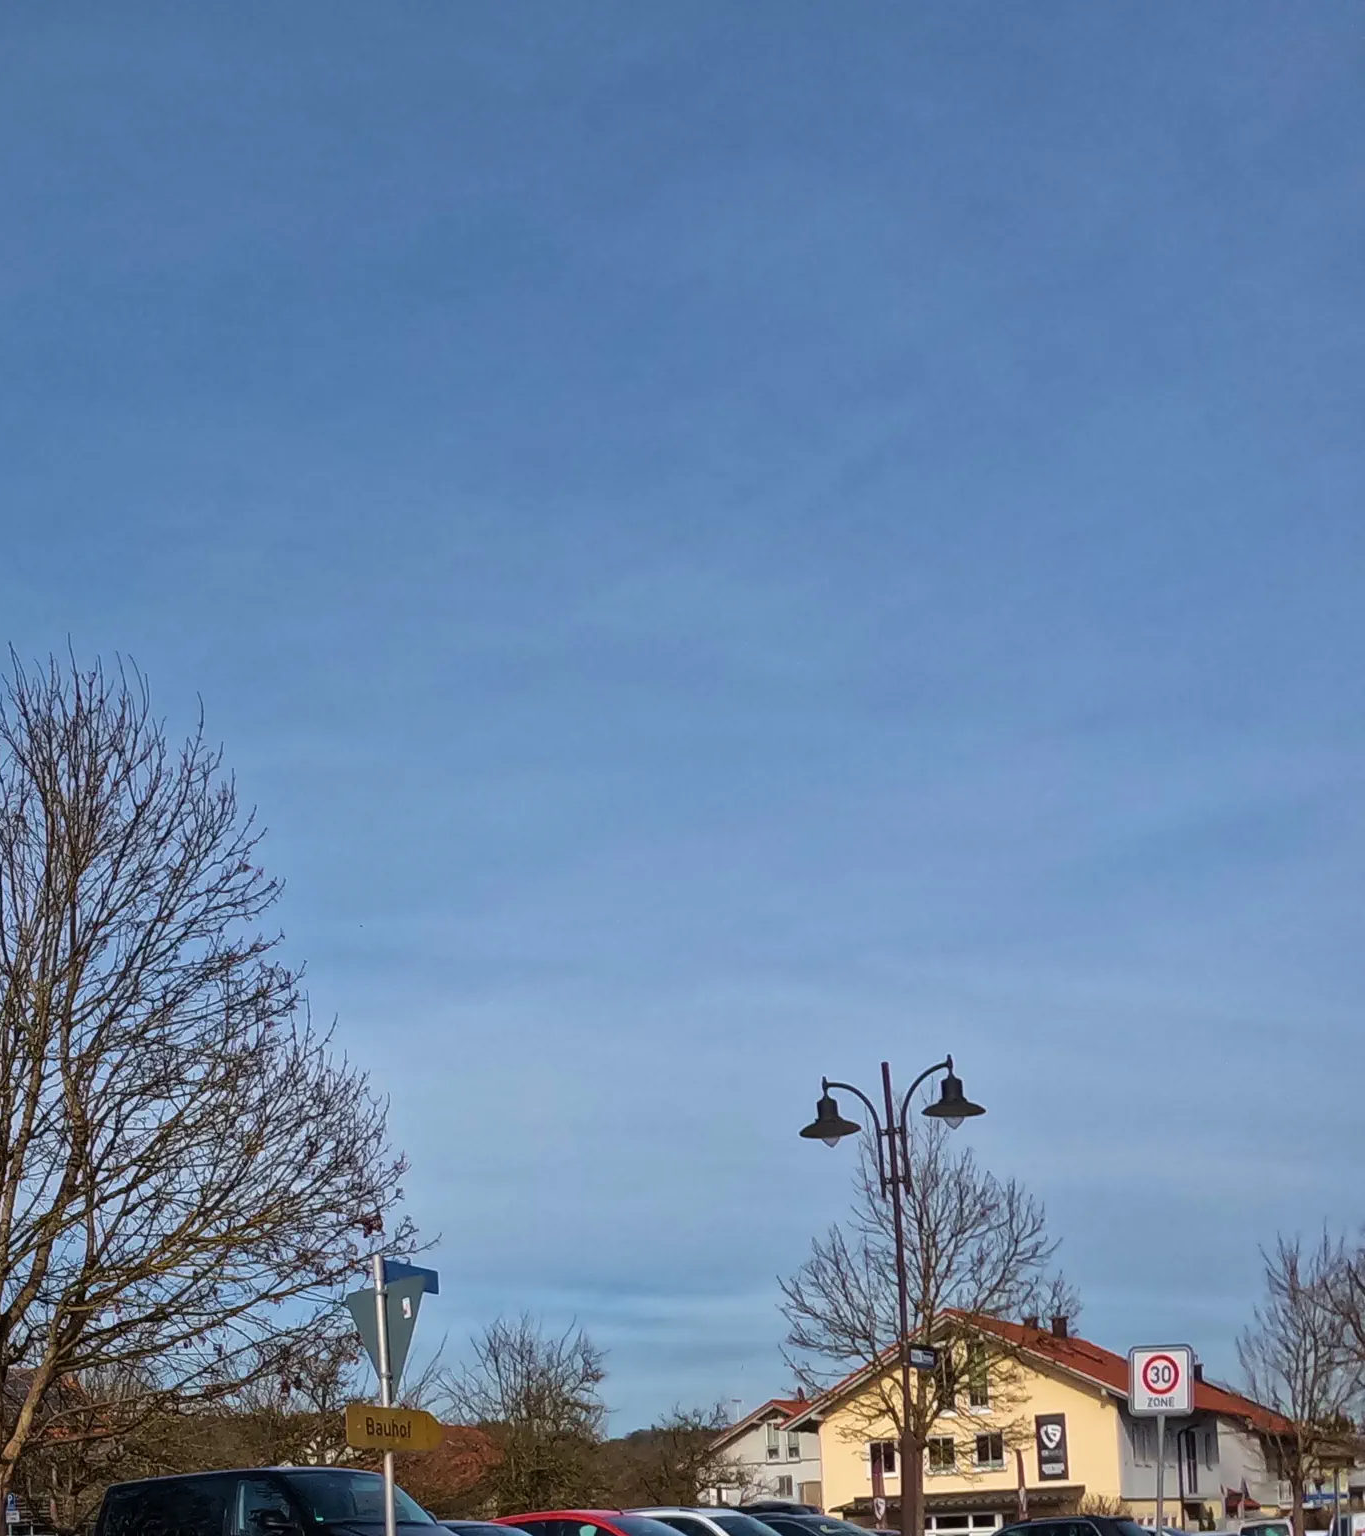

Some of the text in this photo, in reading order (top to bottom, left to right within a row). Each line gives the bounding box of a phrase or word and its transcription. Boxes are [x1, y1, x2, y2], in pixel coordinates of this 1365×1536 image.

[1150, 1365, 1171, 1384] 30
[1147, 1396, 1175, 1408] ZONE
[365, 1416, 411, 1439] Bauhof
